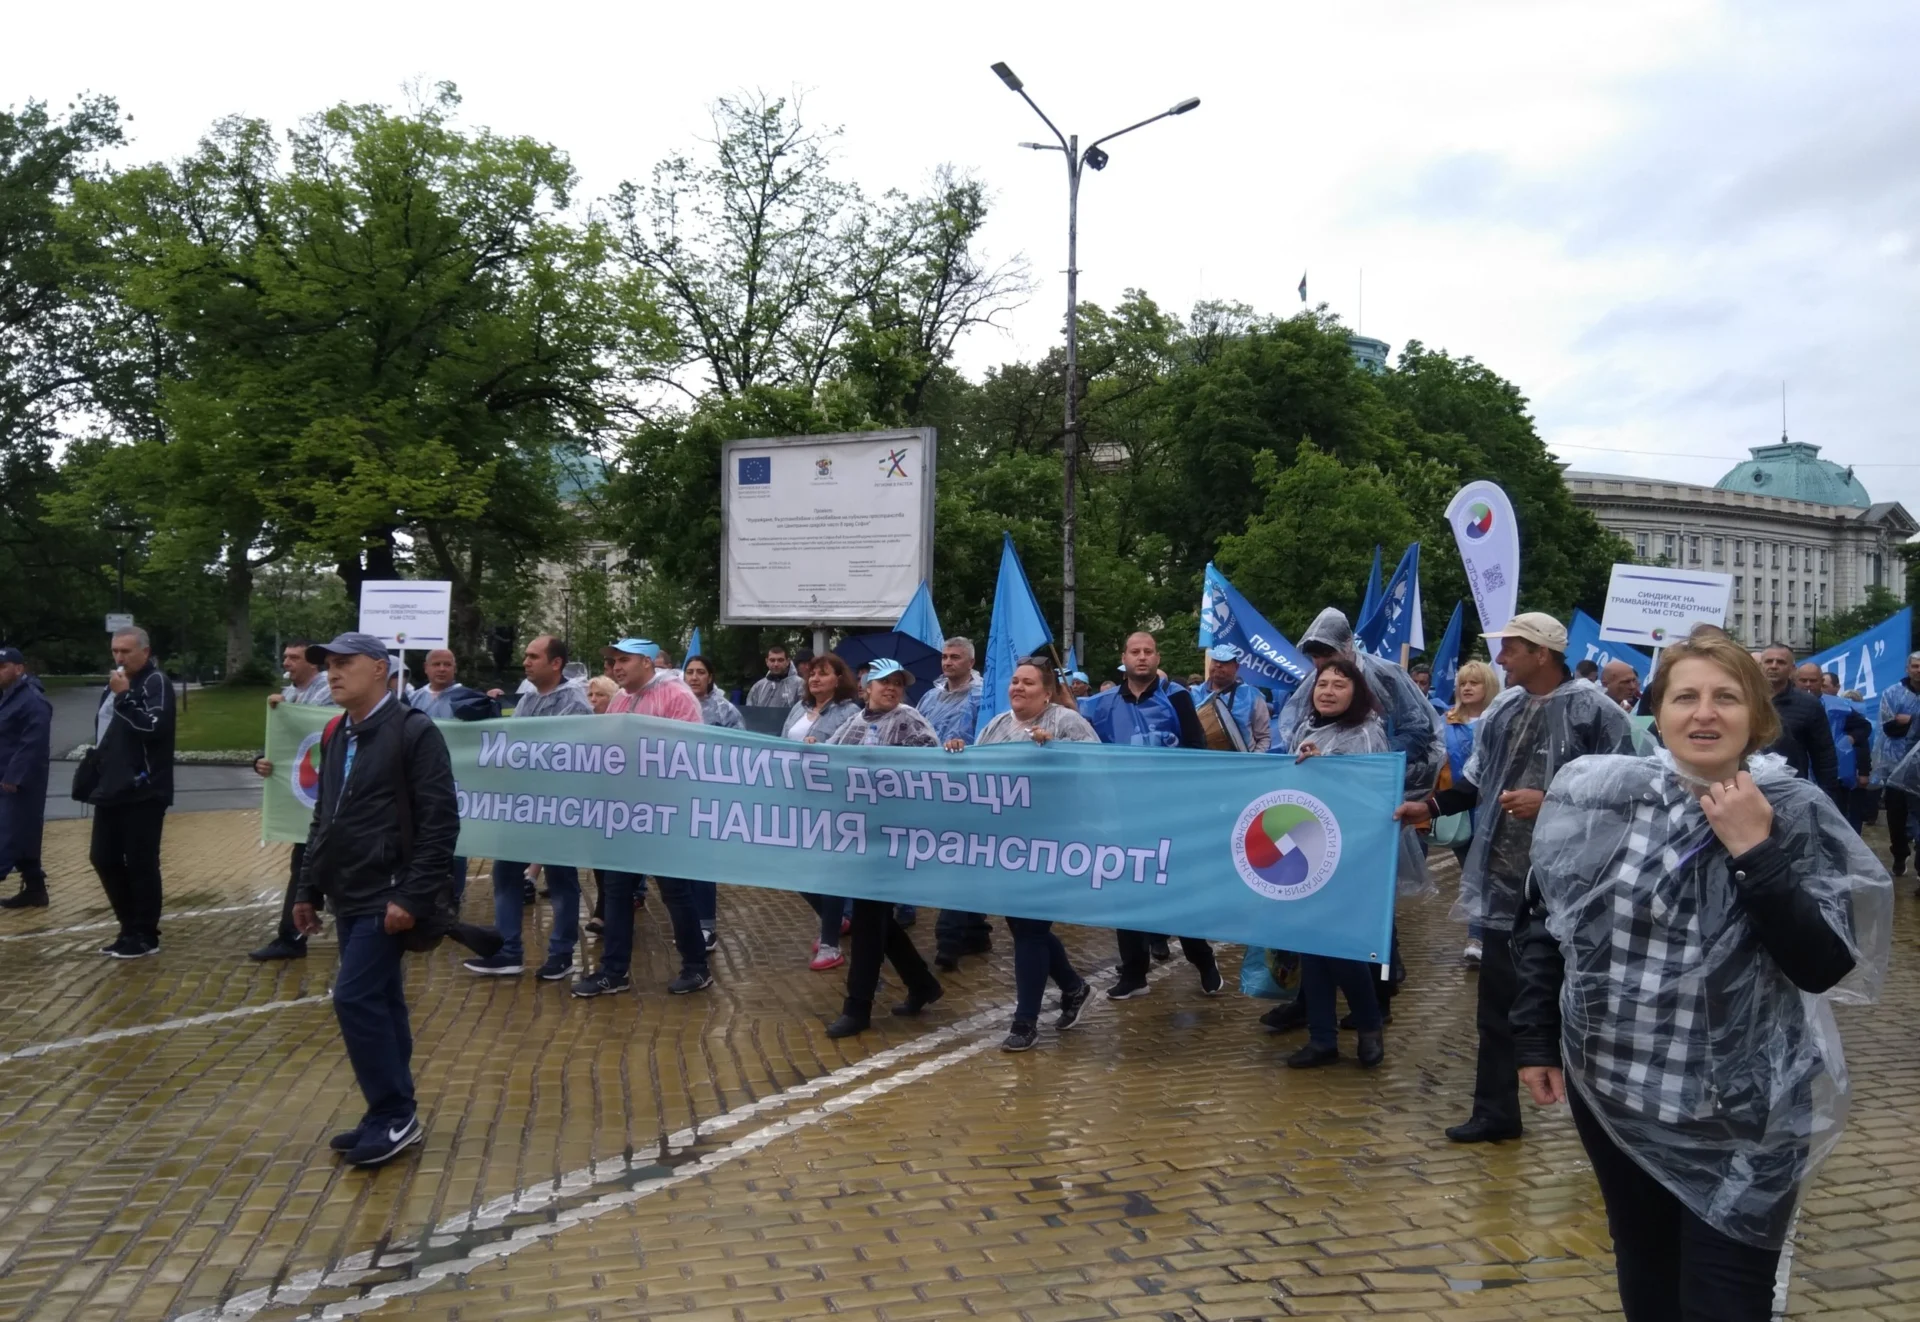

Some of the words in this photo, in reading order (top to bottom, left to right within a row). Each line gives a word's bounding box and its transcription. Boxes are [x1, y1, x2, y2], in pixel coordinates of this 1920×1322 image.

[1611, 596, 1669, 609] ТРАМВАЙНИТЕ
[1670, 602, 1721, 614] РАБОТНИЦИ
[1637, 591, 1682, 602] СИНДИКАТ
[1641, 607, 1661, 615] КЪМ
[1662, 610, 1685, 618] СТСБ
[477, 729, 626, 776] Искаме
[638, 736, 830, 793] НАШИТЕ
[845, 765, 1031, 815] данъци
[1235, 794, 1294, 856] ТРАНСПОРТНИТЕ
[1296, 795, 1337, 848] СИНДИКАТИ
[690, 797, 867, 855] НАШИЯ
[881, 823, 1171, 890] транспорт!
[1238, 856, 1250, 873] НА
[1284, 859, 1332, 896] БЪЛГАРИЯ
[1246, 871, 1276, 894] СЪЮЗ
